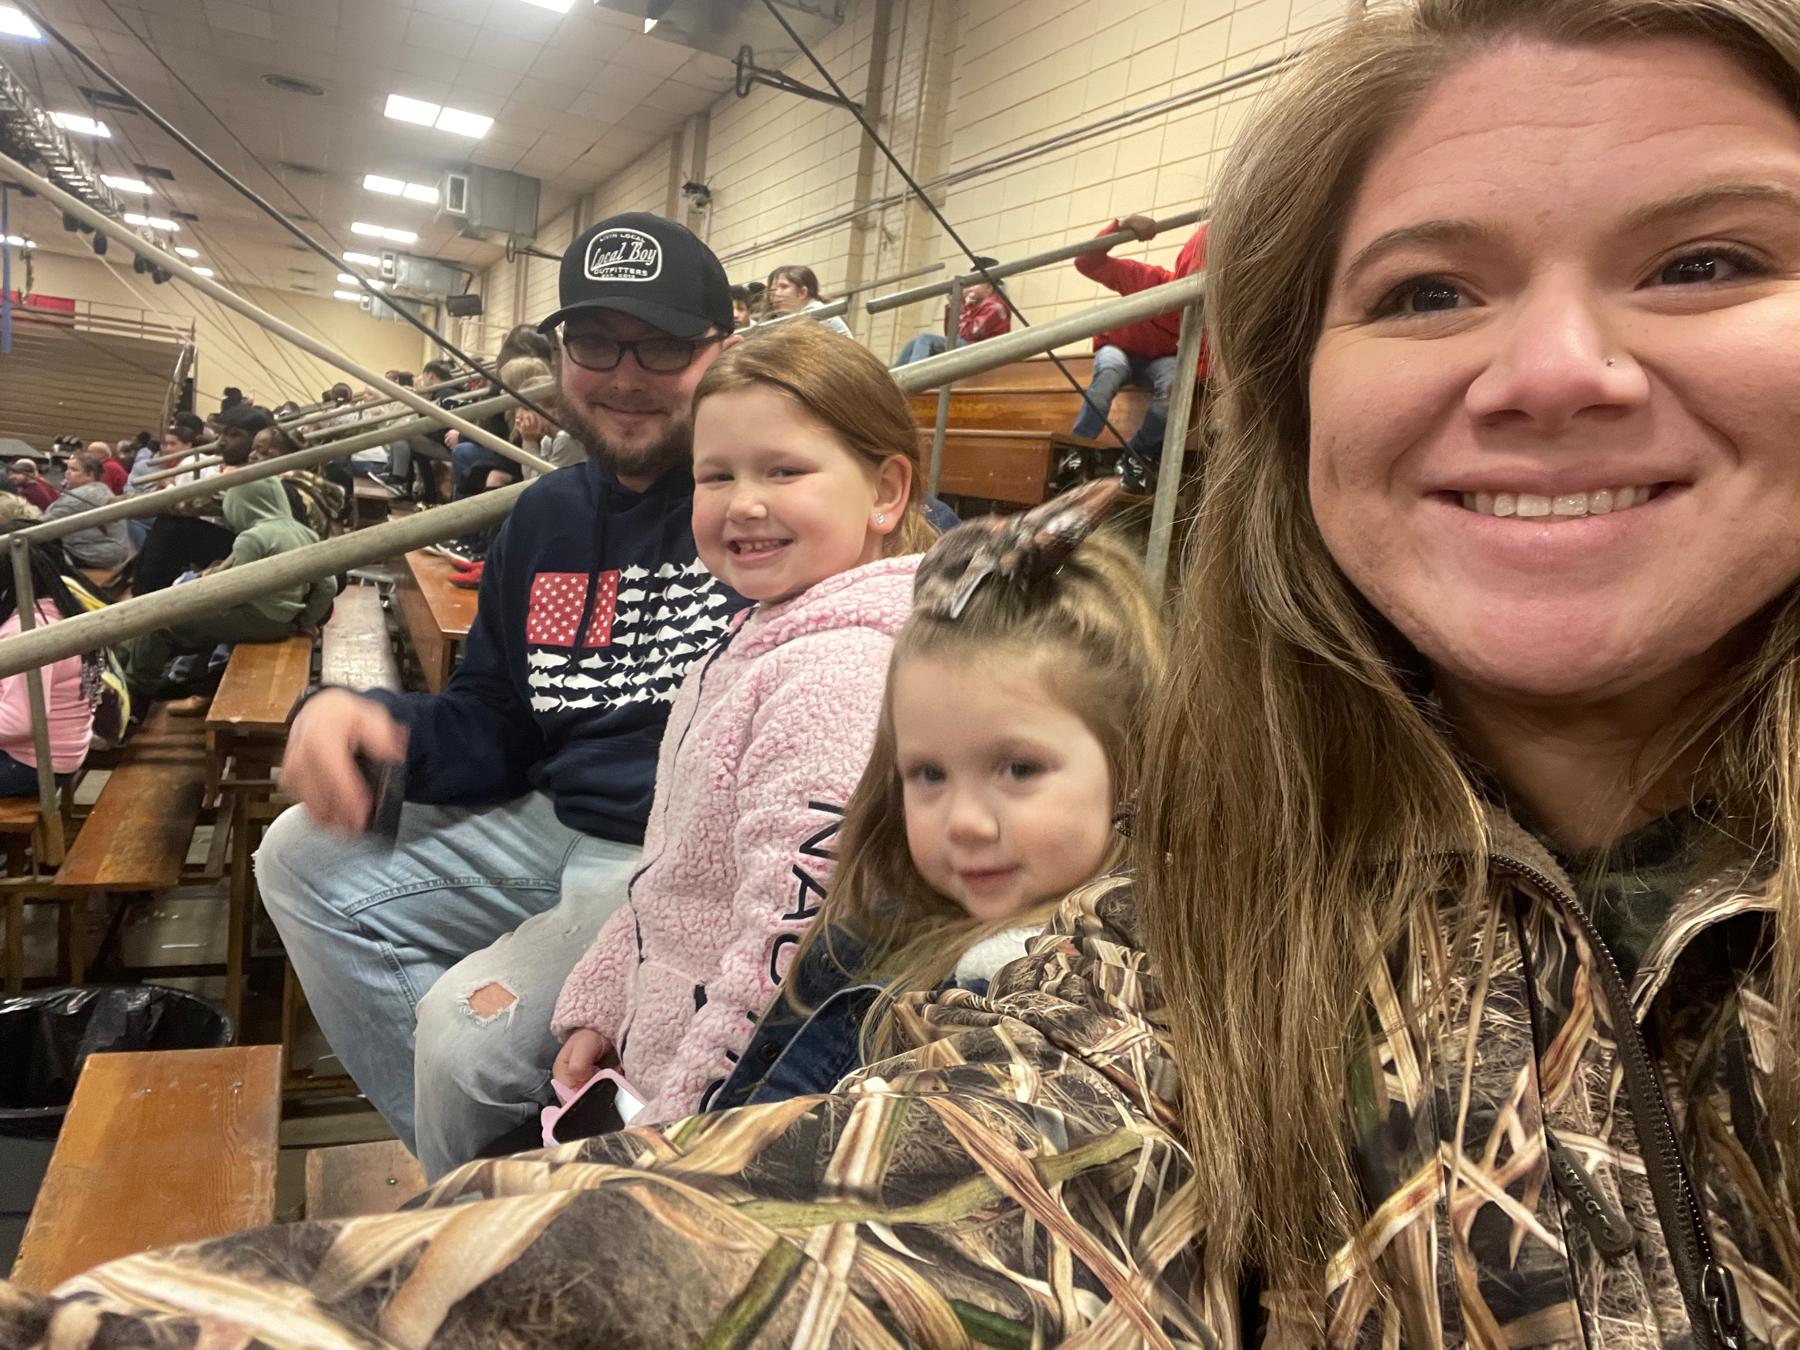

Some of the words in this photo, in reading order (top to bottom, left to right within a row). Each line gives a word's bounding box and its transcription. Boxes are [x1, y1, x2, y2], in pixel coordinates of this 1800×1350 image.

[619, 233, 646, 243] LOCAL
[591, 241, 626, 271] Local
[629, 241, 657, 266] Boy
[593, 266, 648, 277] OUTFITTERS
